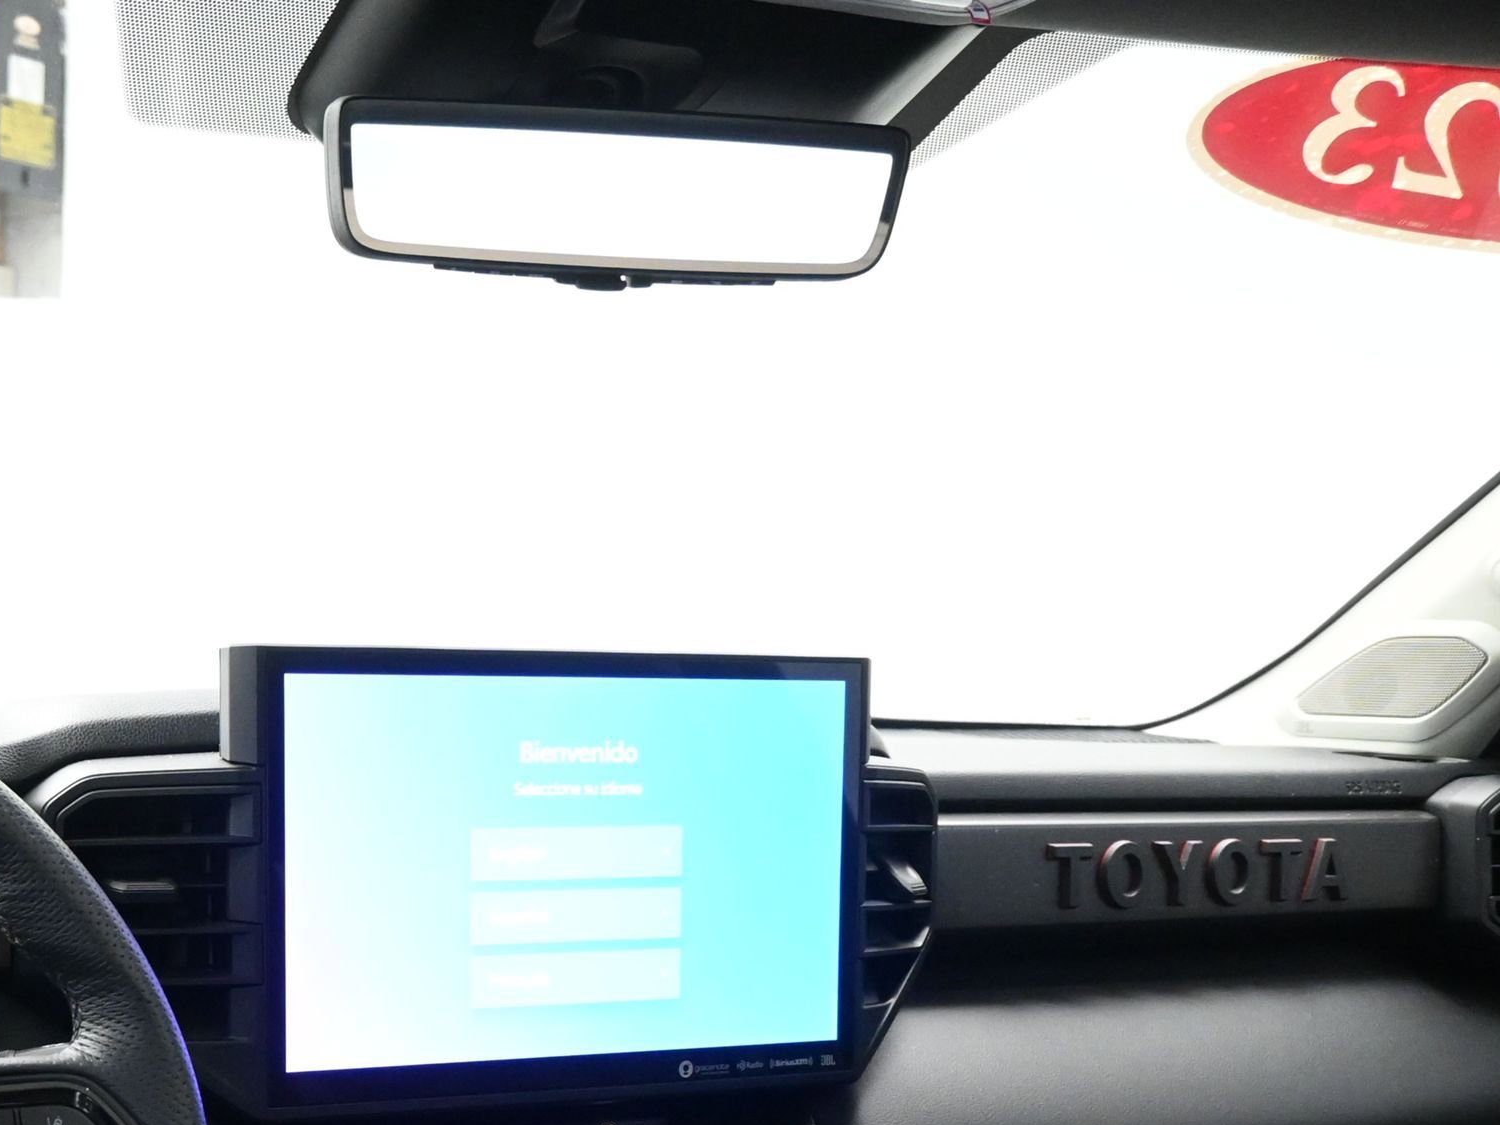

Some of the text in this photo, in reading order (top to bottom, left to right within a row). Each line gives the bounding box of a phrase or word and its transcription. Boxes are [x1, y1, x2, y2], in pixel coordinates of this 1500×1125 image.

[520, 740, 639, 763] Bienvenido
[1045, 838, 1347, 910] TOYOTA
[820, 1054, 836, 1066] JBL
